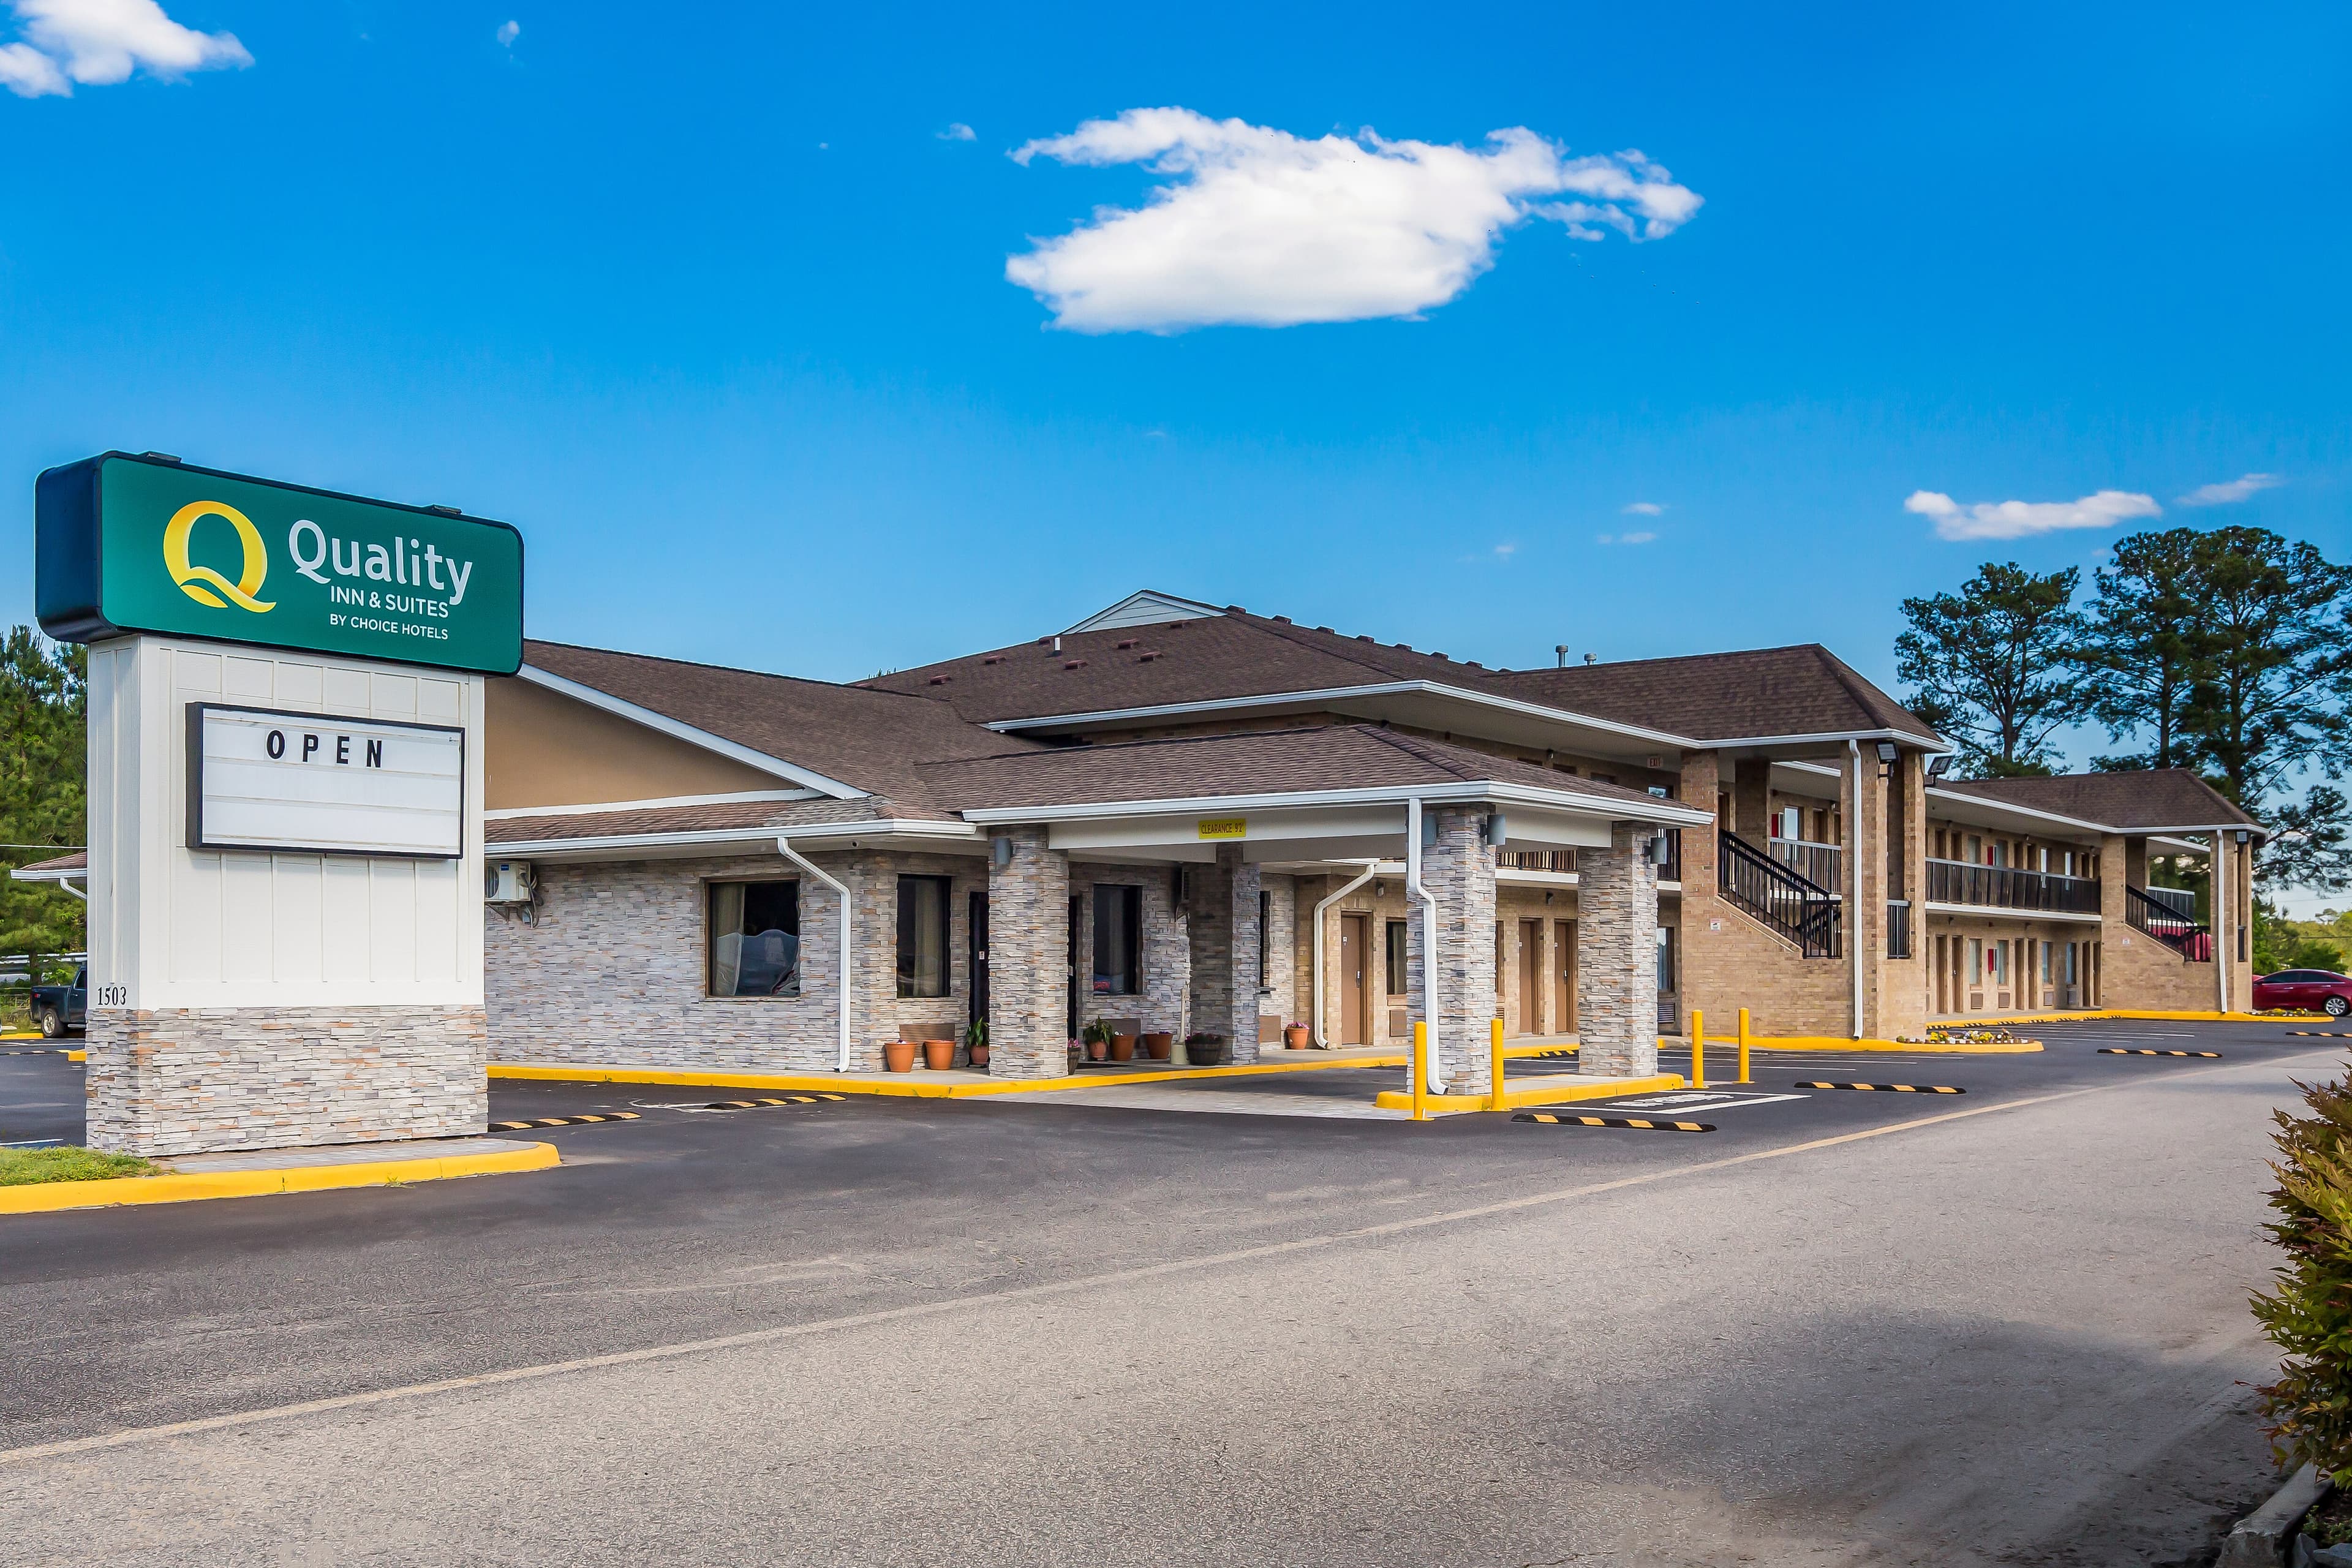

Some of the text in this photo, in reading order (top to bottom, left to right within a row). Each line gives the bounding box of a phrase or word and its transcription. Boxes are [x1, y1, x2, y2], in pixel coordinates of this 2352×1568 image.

[164, 500, 276, 613] Q
[288, 519, 473, 605] Quality
[331, 586, 449, 618] INN & SUITES
[330, 613, 448, 640] BY CHOICE HOTELS
[266, 729, 382, 768] OPEN
[1201, 823, 1232, 834] CLEARANCE
[97, 986, 127, 1006] 1503
